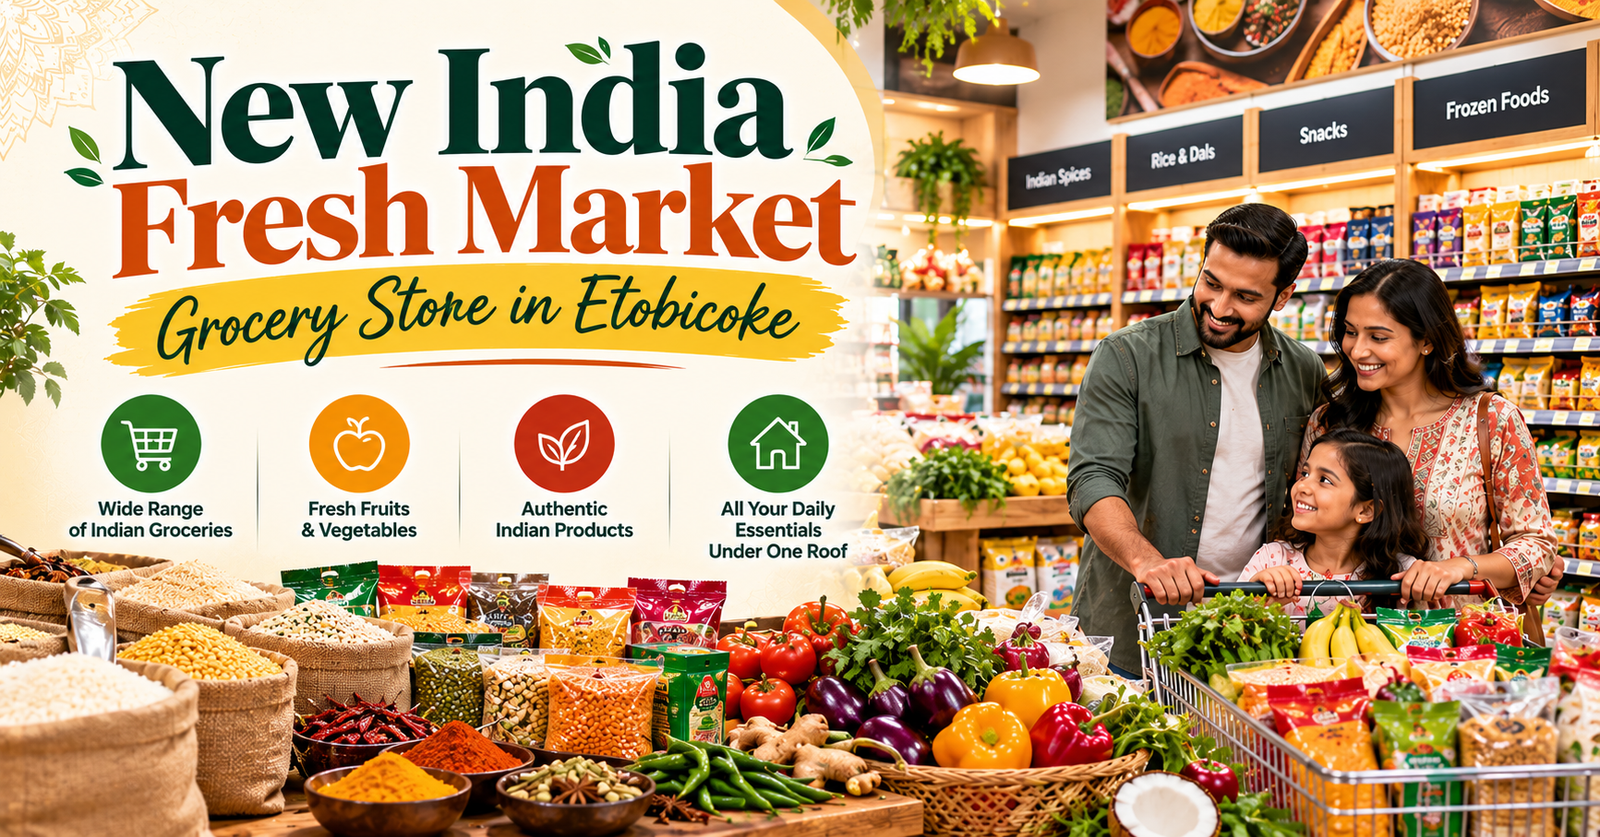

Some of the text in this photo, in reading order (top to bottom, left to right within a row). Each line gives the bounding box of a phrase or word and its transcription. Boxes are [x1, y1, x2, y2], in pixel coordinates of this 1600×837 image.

[1446, 85, 1550, 120] Frozen Foods
[1299, 120, 1348, 145] Snacks
[1151, 143, 1216, 169] Rice & Dals
[1025, 166, 1092, 190] Indian Spices
